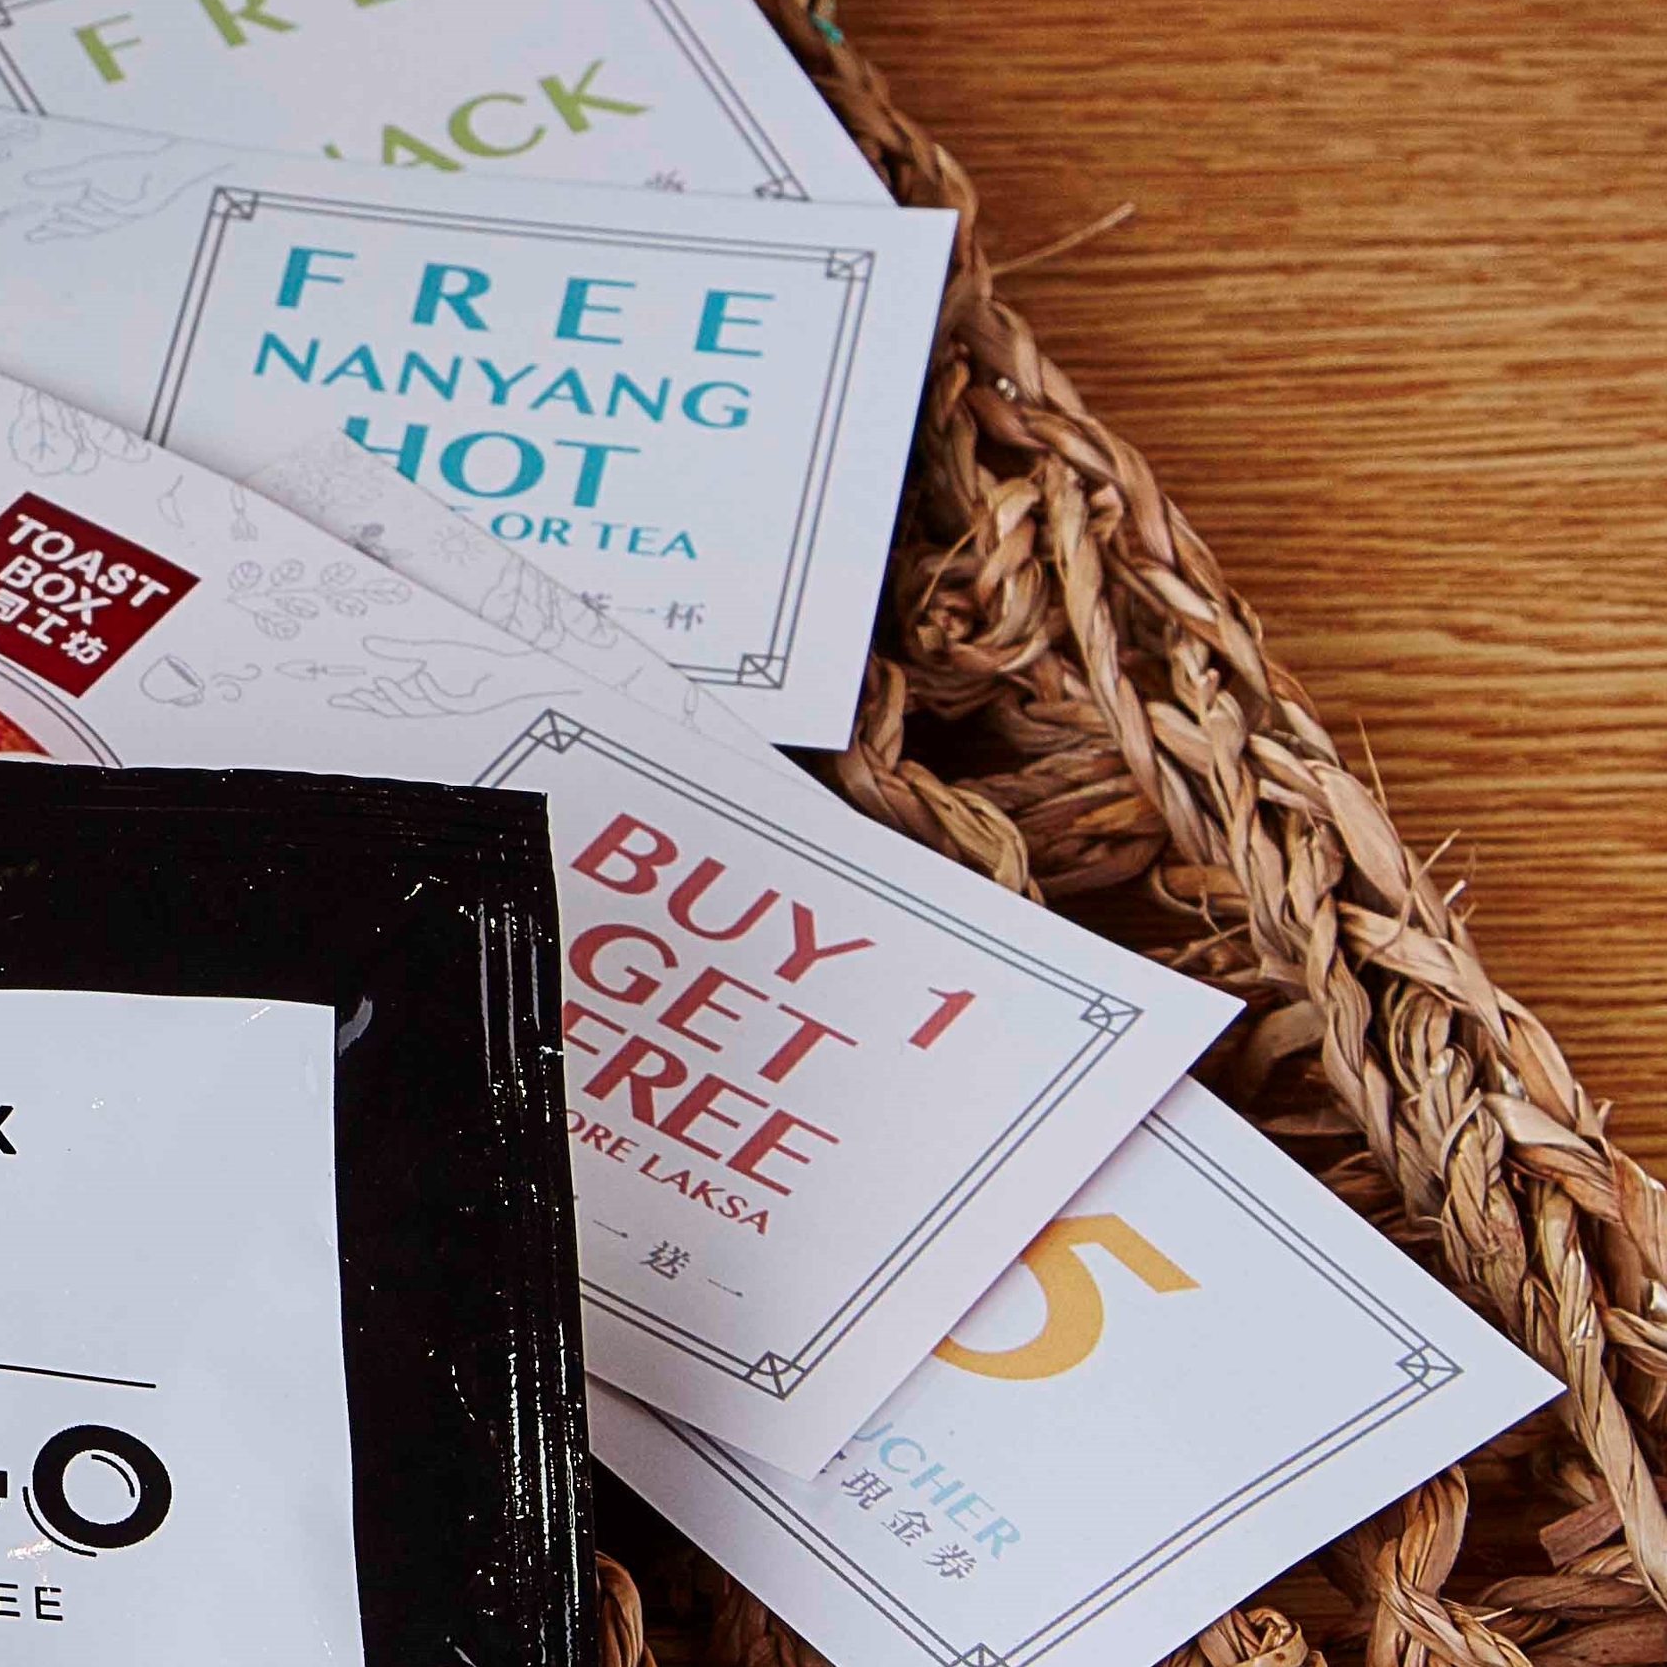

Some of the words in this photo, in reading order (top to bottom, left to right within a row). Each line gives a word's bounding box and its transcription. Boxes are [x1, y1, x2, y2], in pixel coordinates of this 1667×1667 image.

[323, 59, 651, 173] ACK
[274, 246, 776, 359] FREE
[252, 332, 755, 431] NANYANG
[339, 415, 643, 510] HOT
[7, 513, 171, 608] TOAST
[490, 512, 573, 546] OR
[591, 520, 698, 560] TEA
[570, 812, 875, 984] BUY
[906, 986, 978, 1050] 1
[567, 922, 859, 1085] GET
[561, 999, 841, 1197] FREE
[566, 1108, 640, 1164] ORE
[638, 1153, 771, 1236] LAKSA
[592, 1217, 745, 1299] 一送一
[932, 1214, 1200, 1381] 5
[832, 1462, 978, 1580] 現金券
